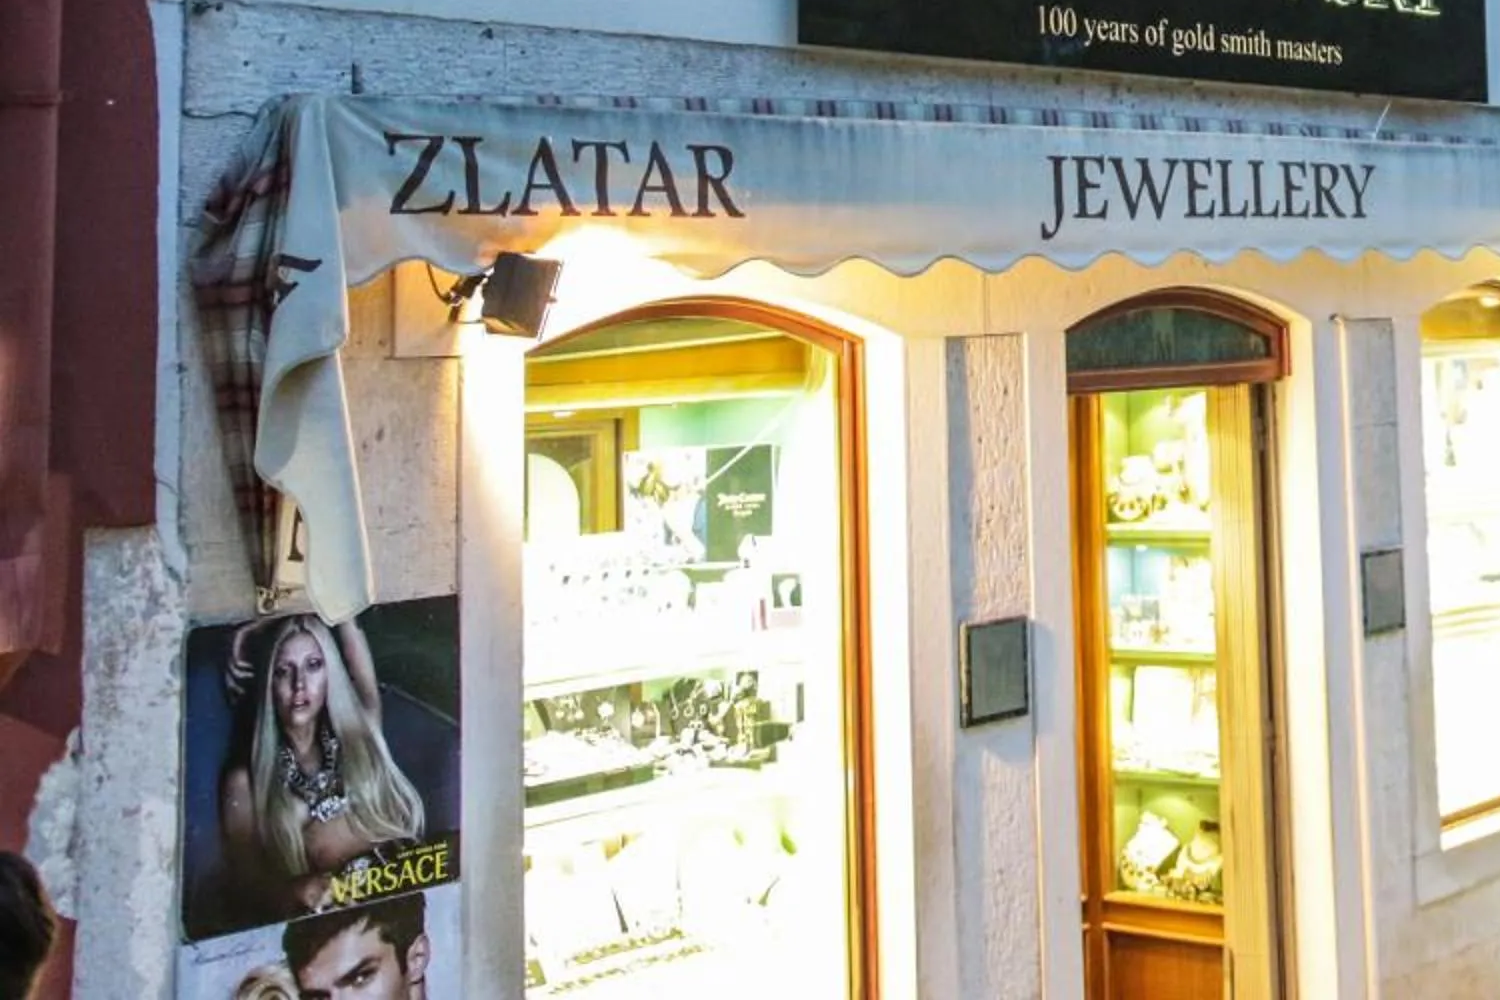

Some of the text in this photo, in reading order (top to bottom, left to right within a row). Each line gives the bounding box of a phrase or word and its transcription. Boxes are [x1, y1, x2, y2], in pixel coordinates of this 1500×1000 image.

[1037, 4, 1343, 65] 100 years of gold smith masters
[383, 130, 745, 218] ZLATAR
[1040, 154, 1376, 240] JEWELLERY
[331, 850, 449, 904] VERSACE
